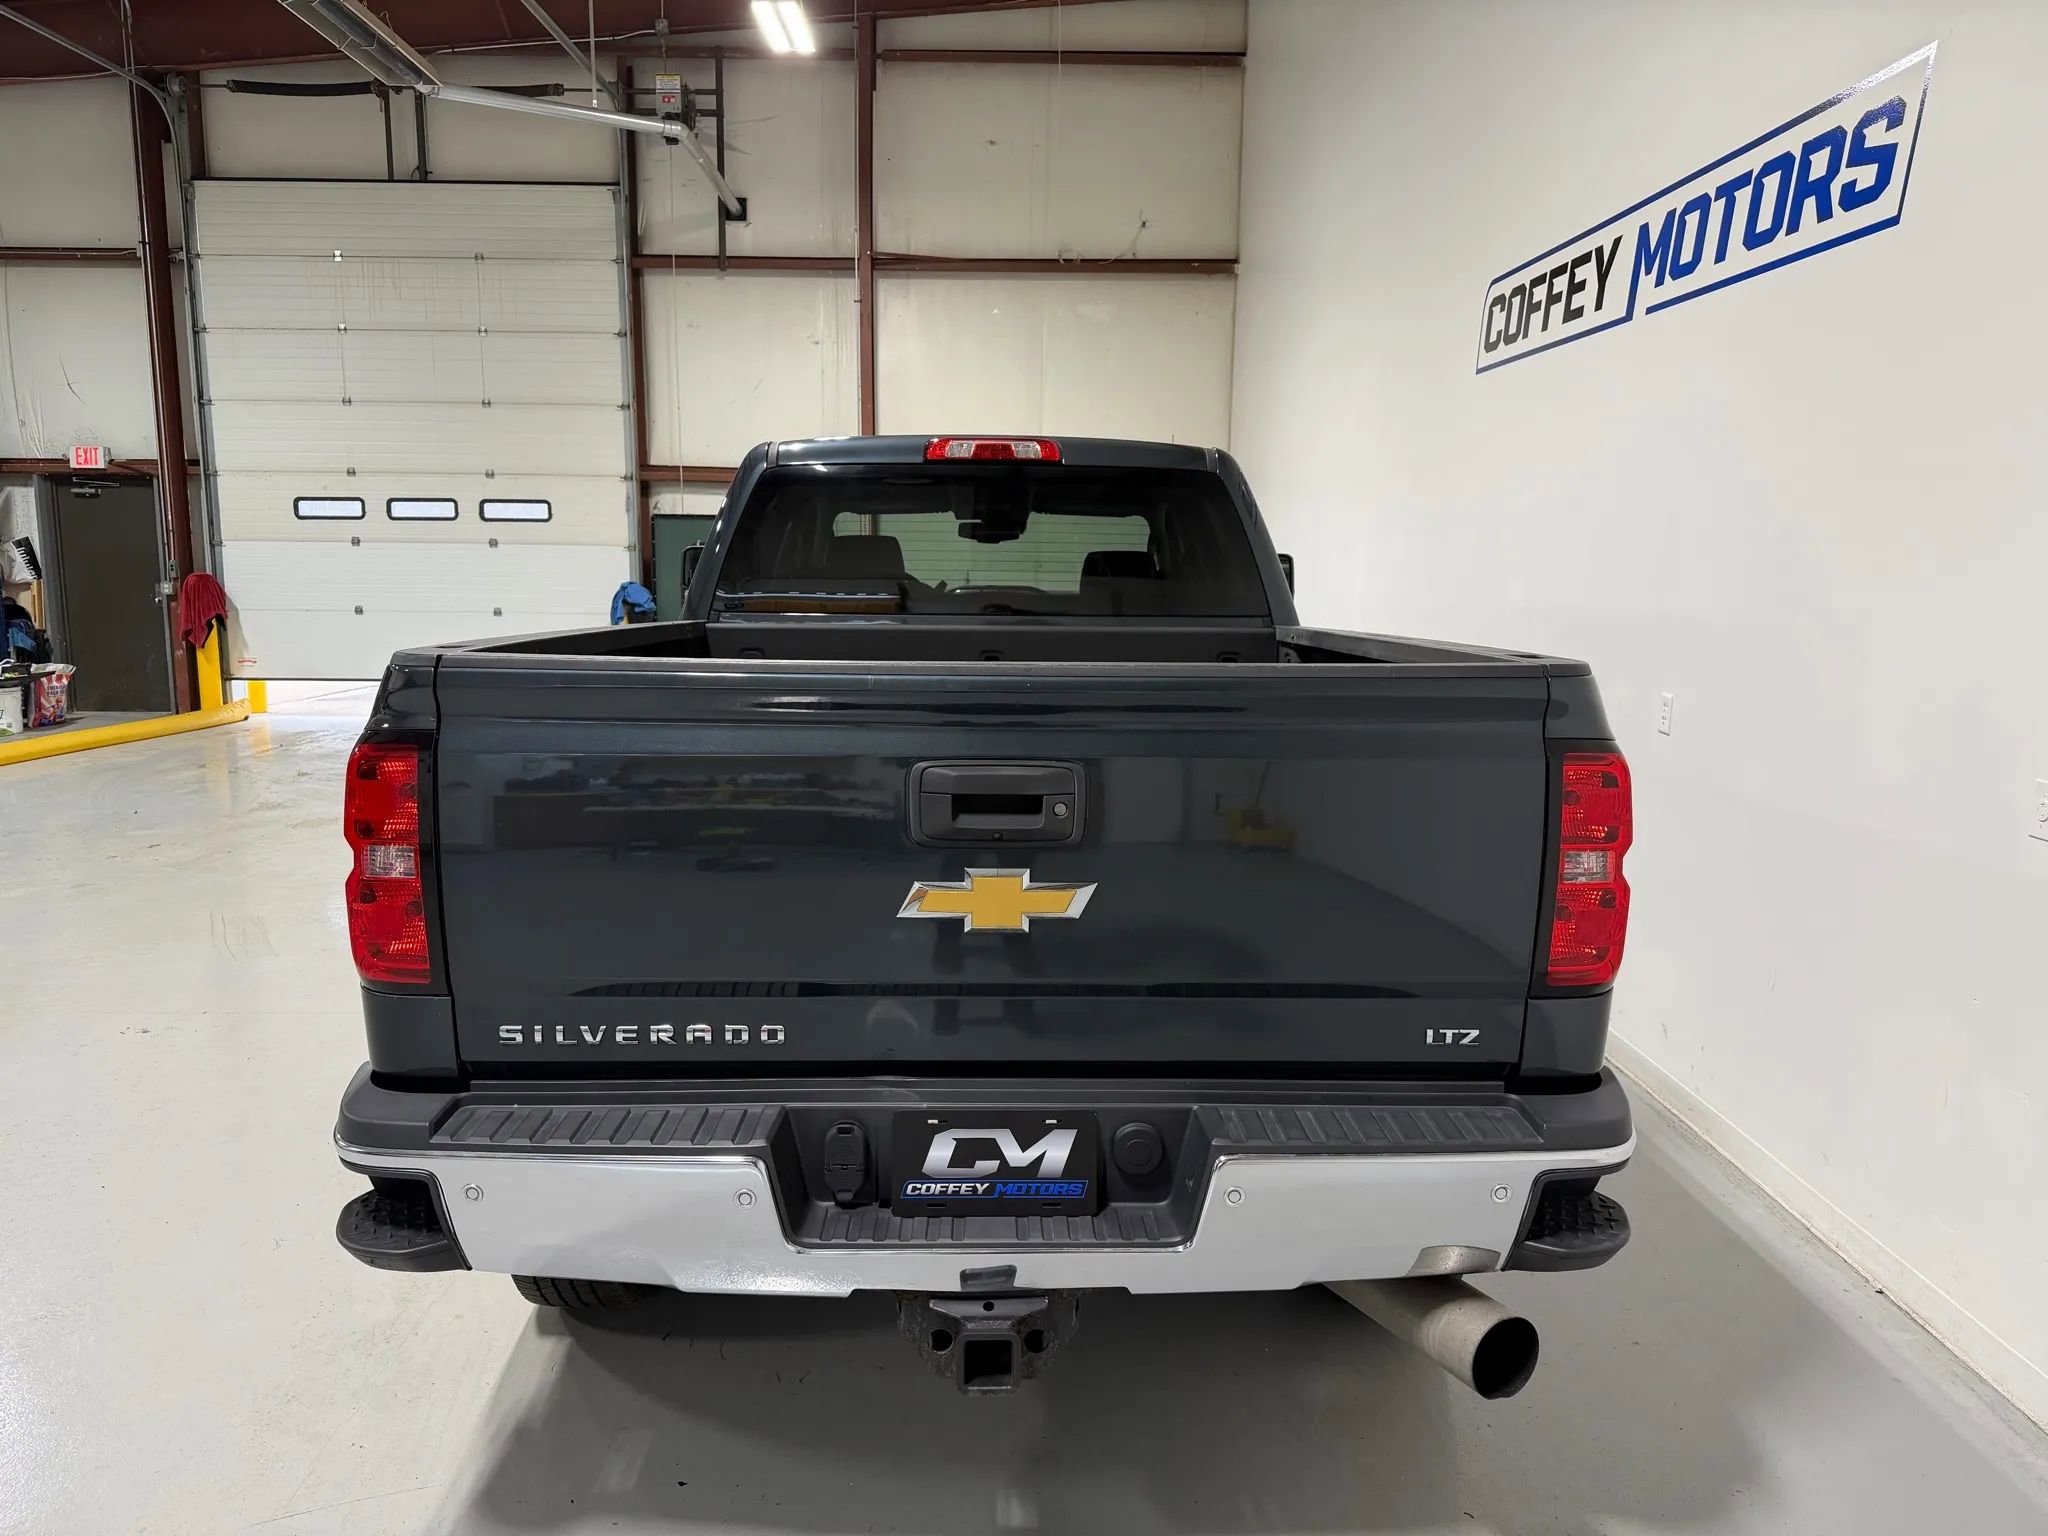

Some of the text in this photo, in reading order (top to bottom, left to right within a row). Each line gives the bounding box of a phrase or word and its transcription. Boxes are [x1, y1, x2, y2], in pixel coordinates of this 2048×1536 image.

[1483, 94, 1907, 354] COFFEY MOTORS
[75, 447, 99, 465] EXIT
[499, 1024, 785, 1045] SILVERADO
[1426, 1028, 1480, 1045] LTZ
[921, 1128, 1078, 1178] CM
[905, 1182, 1083, 1197] COFFEY MOTORS
